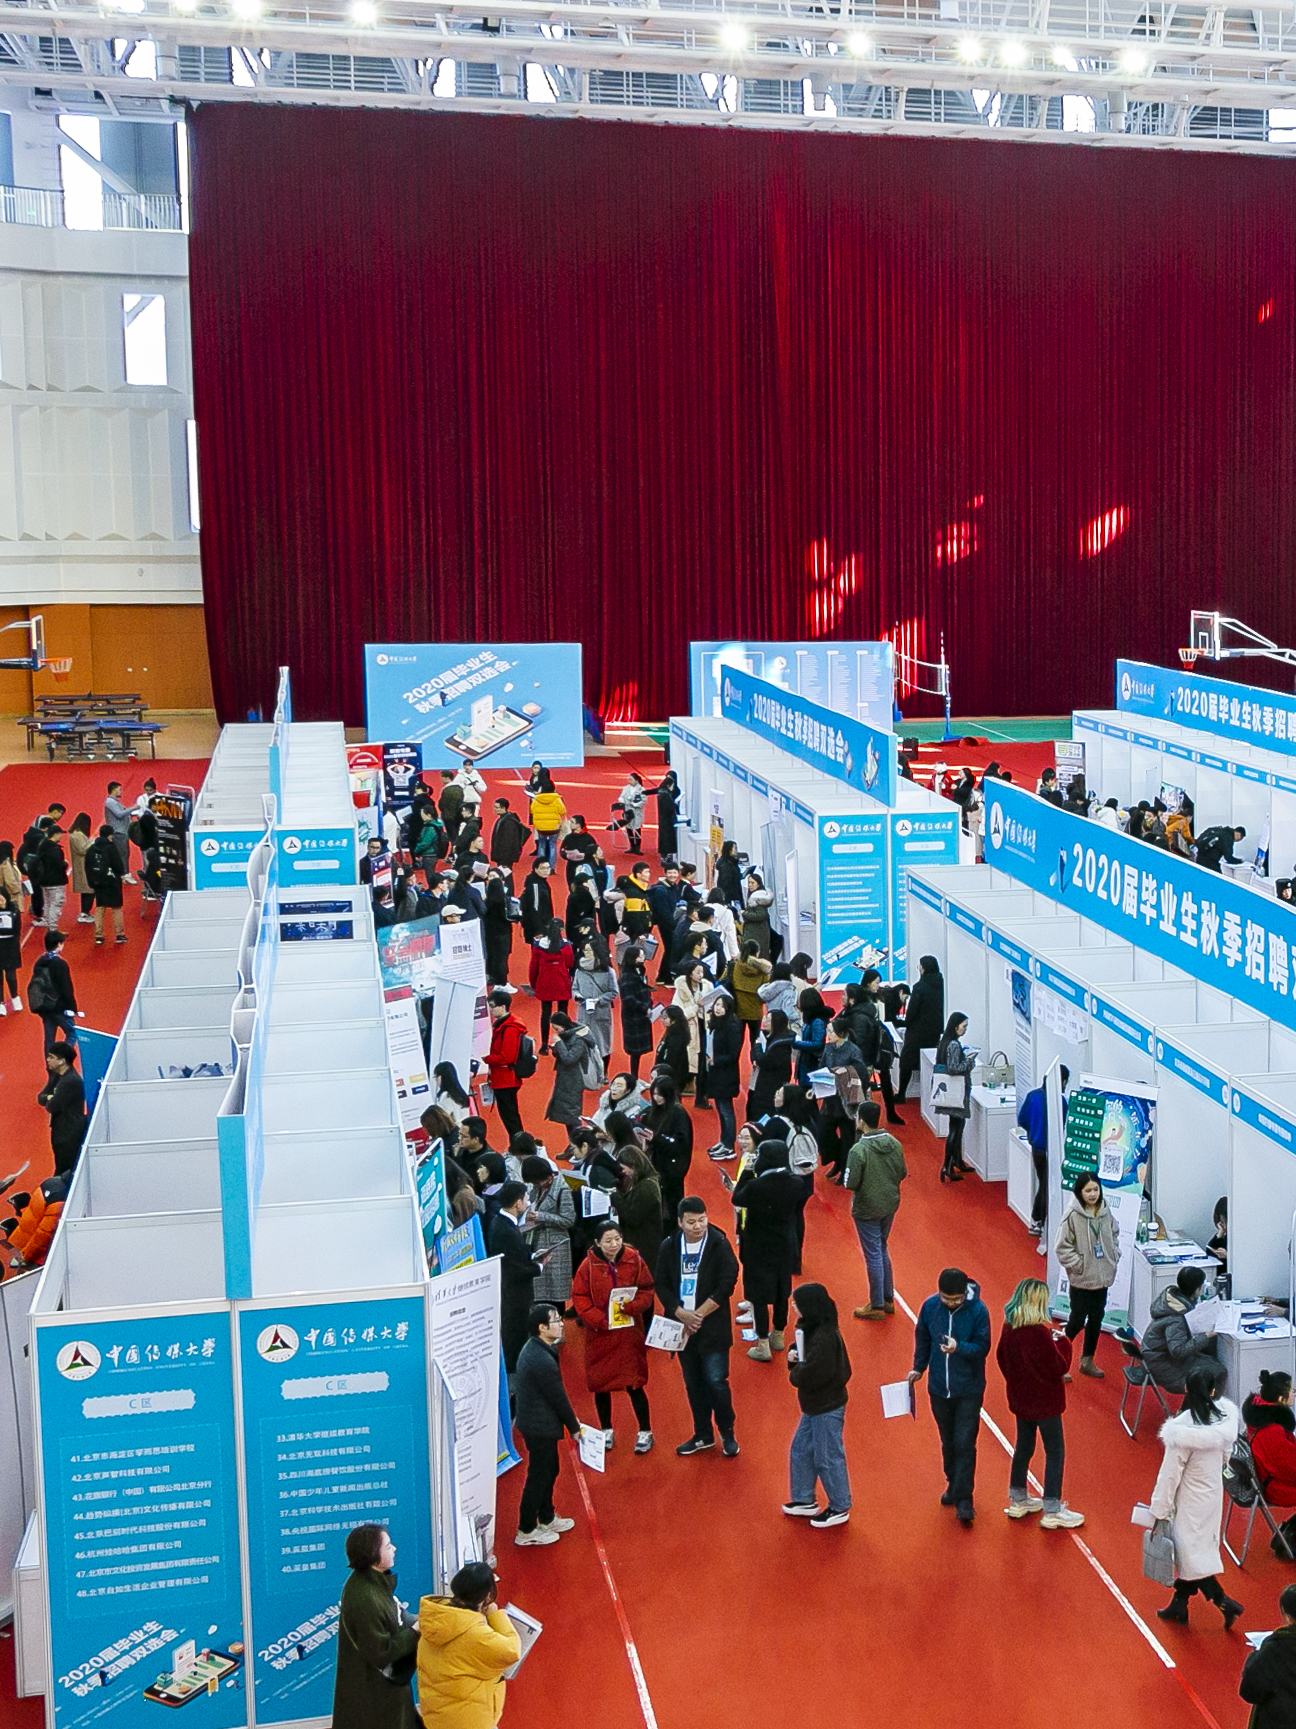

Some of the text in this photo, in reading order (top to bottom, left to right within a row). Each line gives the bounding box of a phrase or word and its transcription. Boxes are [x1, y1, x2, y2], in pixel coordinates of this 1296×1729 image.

[402, 650, 498, 704] 2020届毕业生
[414, 659, 512, 714] 秋季招聘双选会
[753, 692, 844, 764] 2020届毕业生秋季招聘双选会
[105, 1337, 216, 1368] 中国传媒大学
[303, 1321, 409, 1350] 中国传媒大学
[129, 1397, 152, 1409] C区
[326, 1380, 347, 1391] C区
[58, 1620, 163, 1688] 2020届毕业生
[257, 1600, 342, 1663] 2020届毕业
[71, 1628, 179, 1698] 秋季招聘双选会
